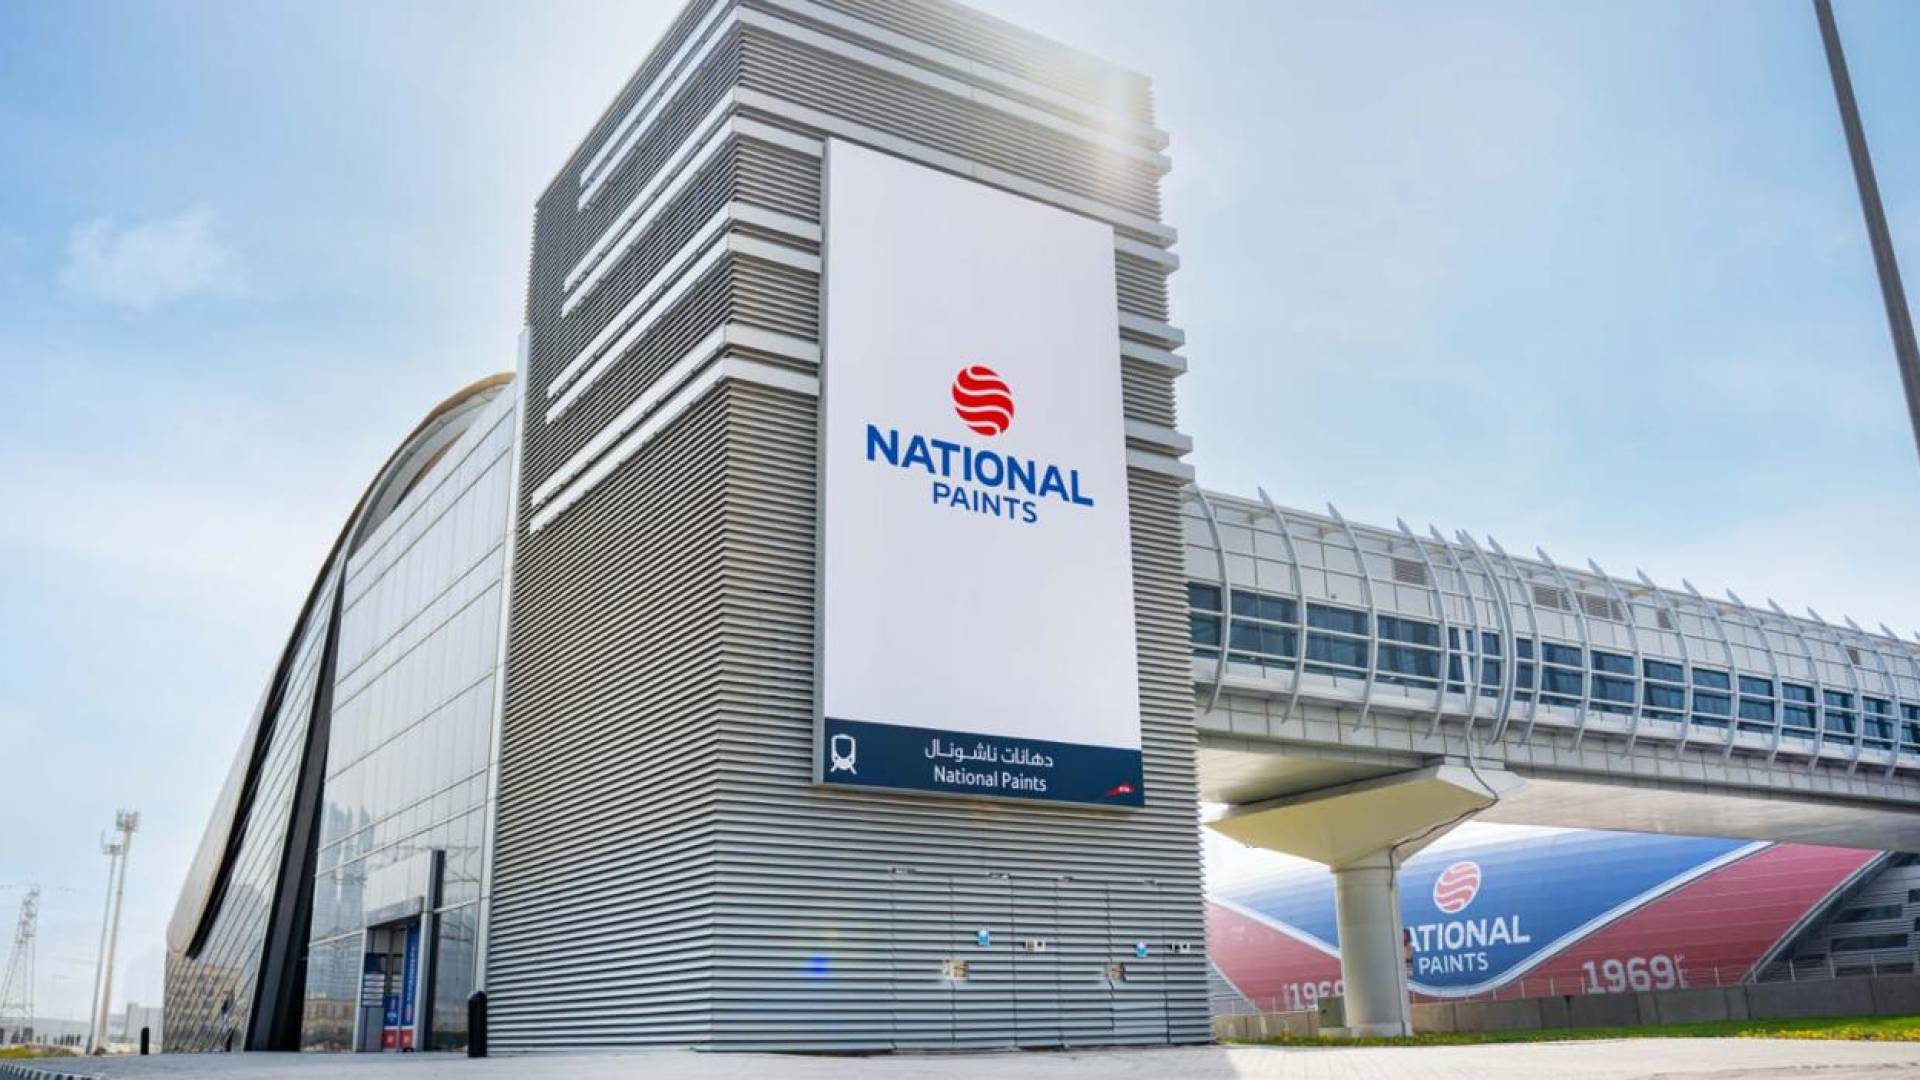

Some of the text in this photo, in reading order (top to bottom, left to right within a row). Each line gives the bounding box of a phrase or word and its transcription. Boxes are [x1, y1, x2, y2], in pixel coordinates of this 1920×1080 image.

[866, 423, 1094, 507] NATIONAL
[933, 481, 1038, 523] PAINTS
[1000, 746, 1054, 768] دهانات
[933, 764, 1047, 792] National Paints
[1418, 952, 1488, 975] PAINTS
[1582, 954, 1675, 995] 1969
